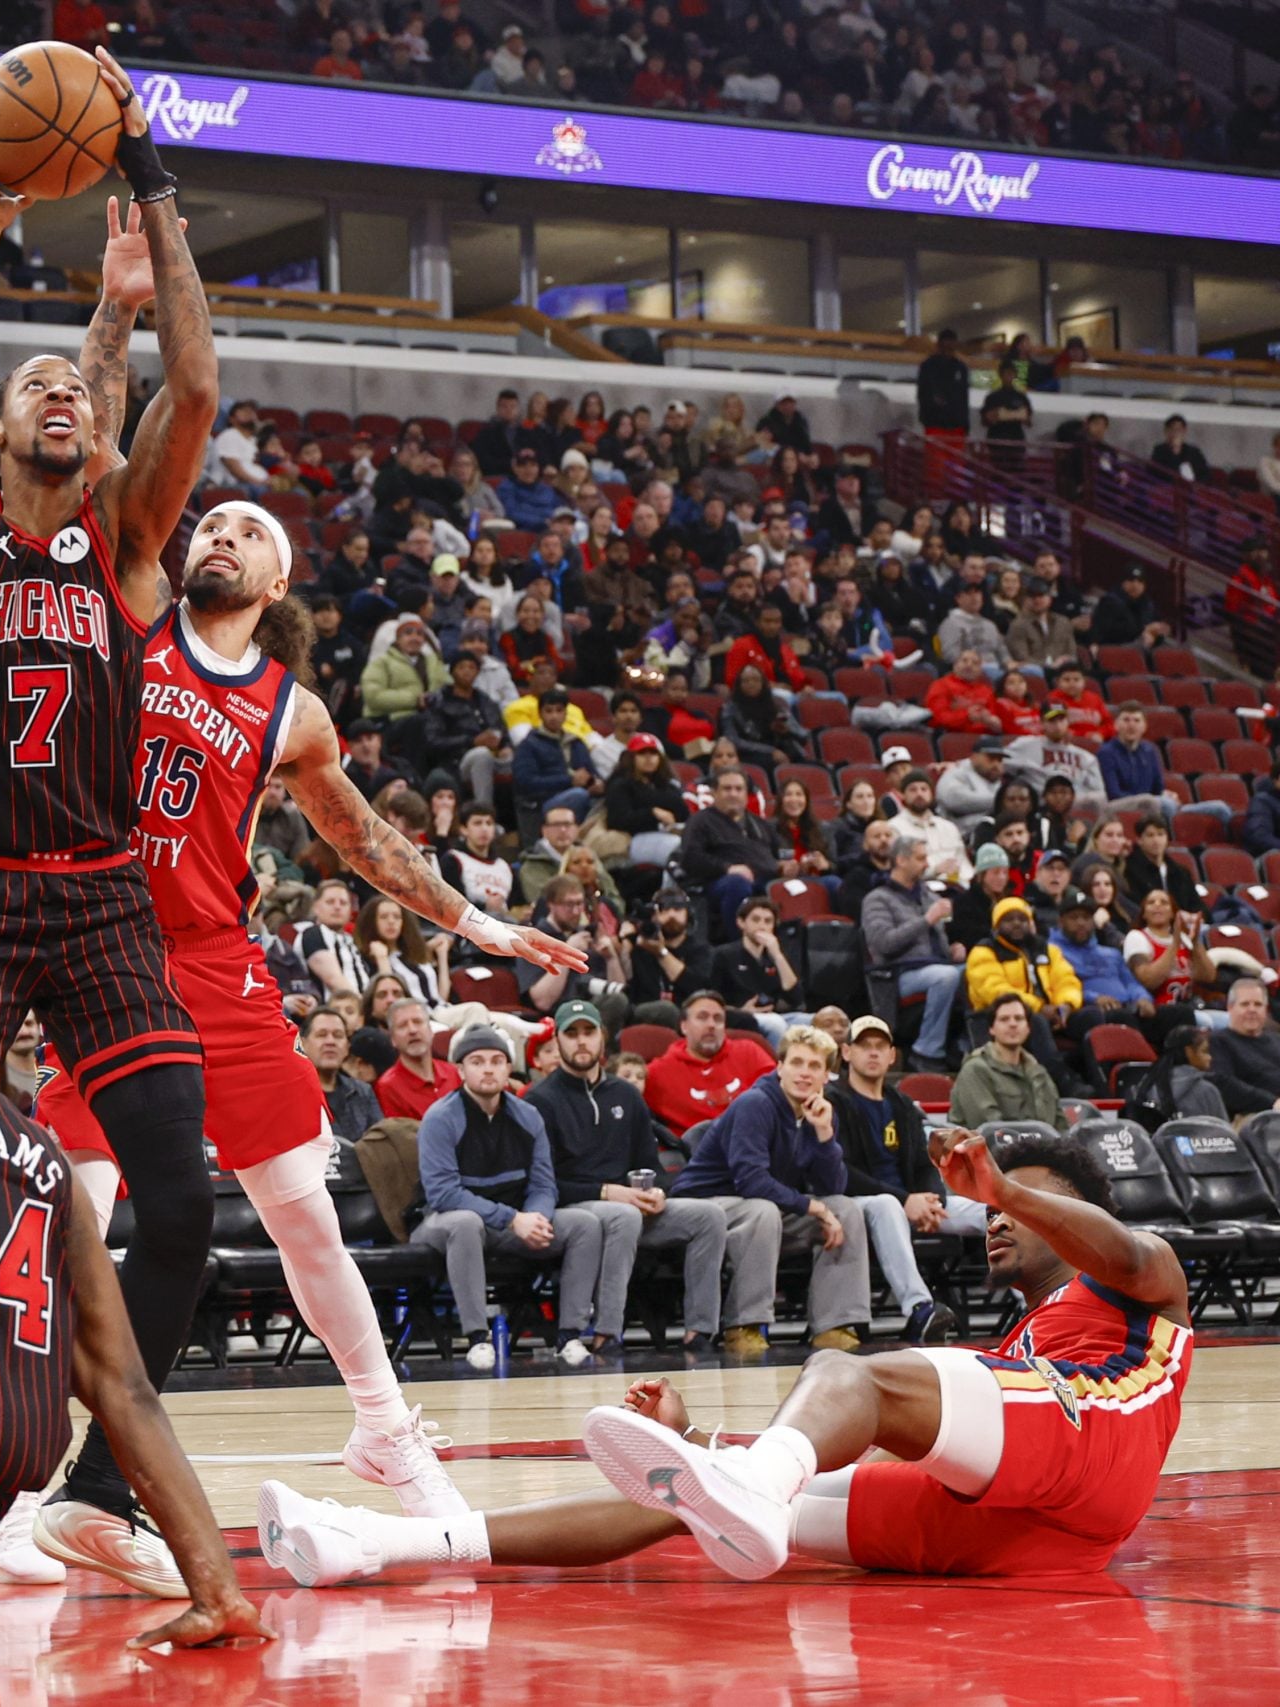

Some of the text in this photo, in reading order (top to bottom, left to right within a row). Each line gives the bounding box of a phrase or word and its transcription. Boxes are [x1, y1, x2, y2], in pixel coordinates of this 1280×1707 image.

[141, 74, 249, 140] Royal
[867, 144, 1040, 213] Crown Royal
[8, 664, 72, 768] 7
[141, 682, 251, 769] RESCENT
[225, 691, 270, 721] NEWAGE
[225, 703, 261, 726] PRODUCTS
[137, 735, 207, 820] 15
[128, 826, 188, 868] CITY
